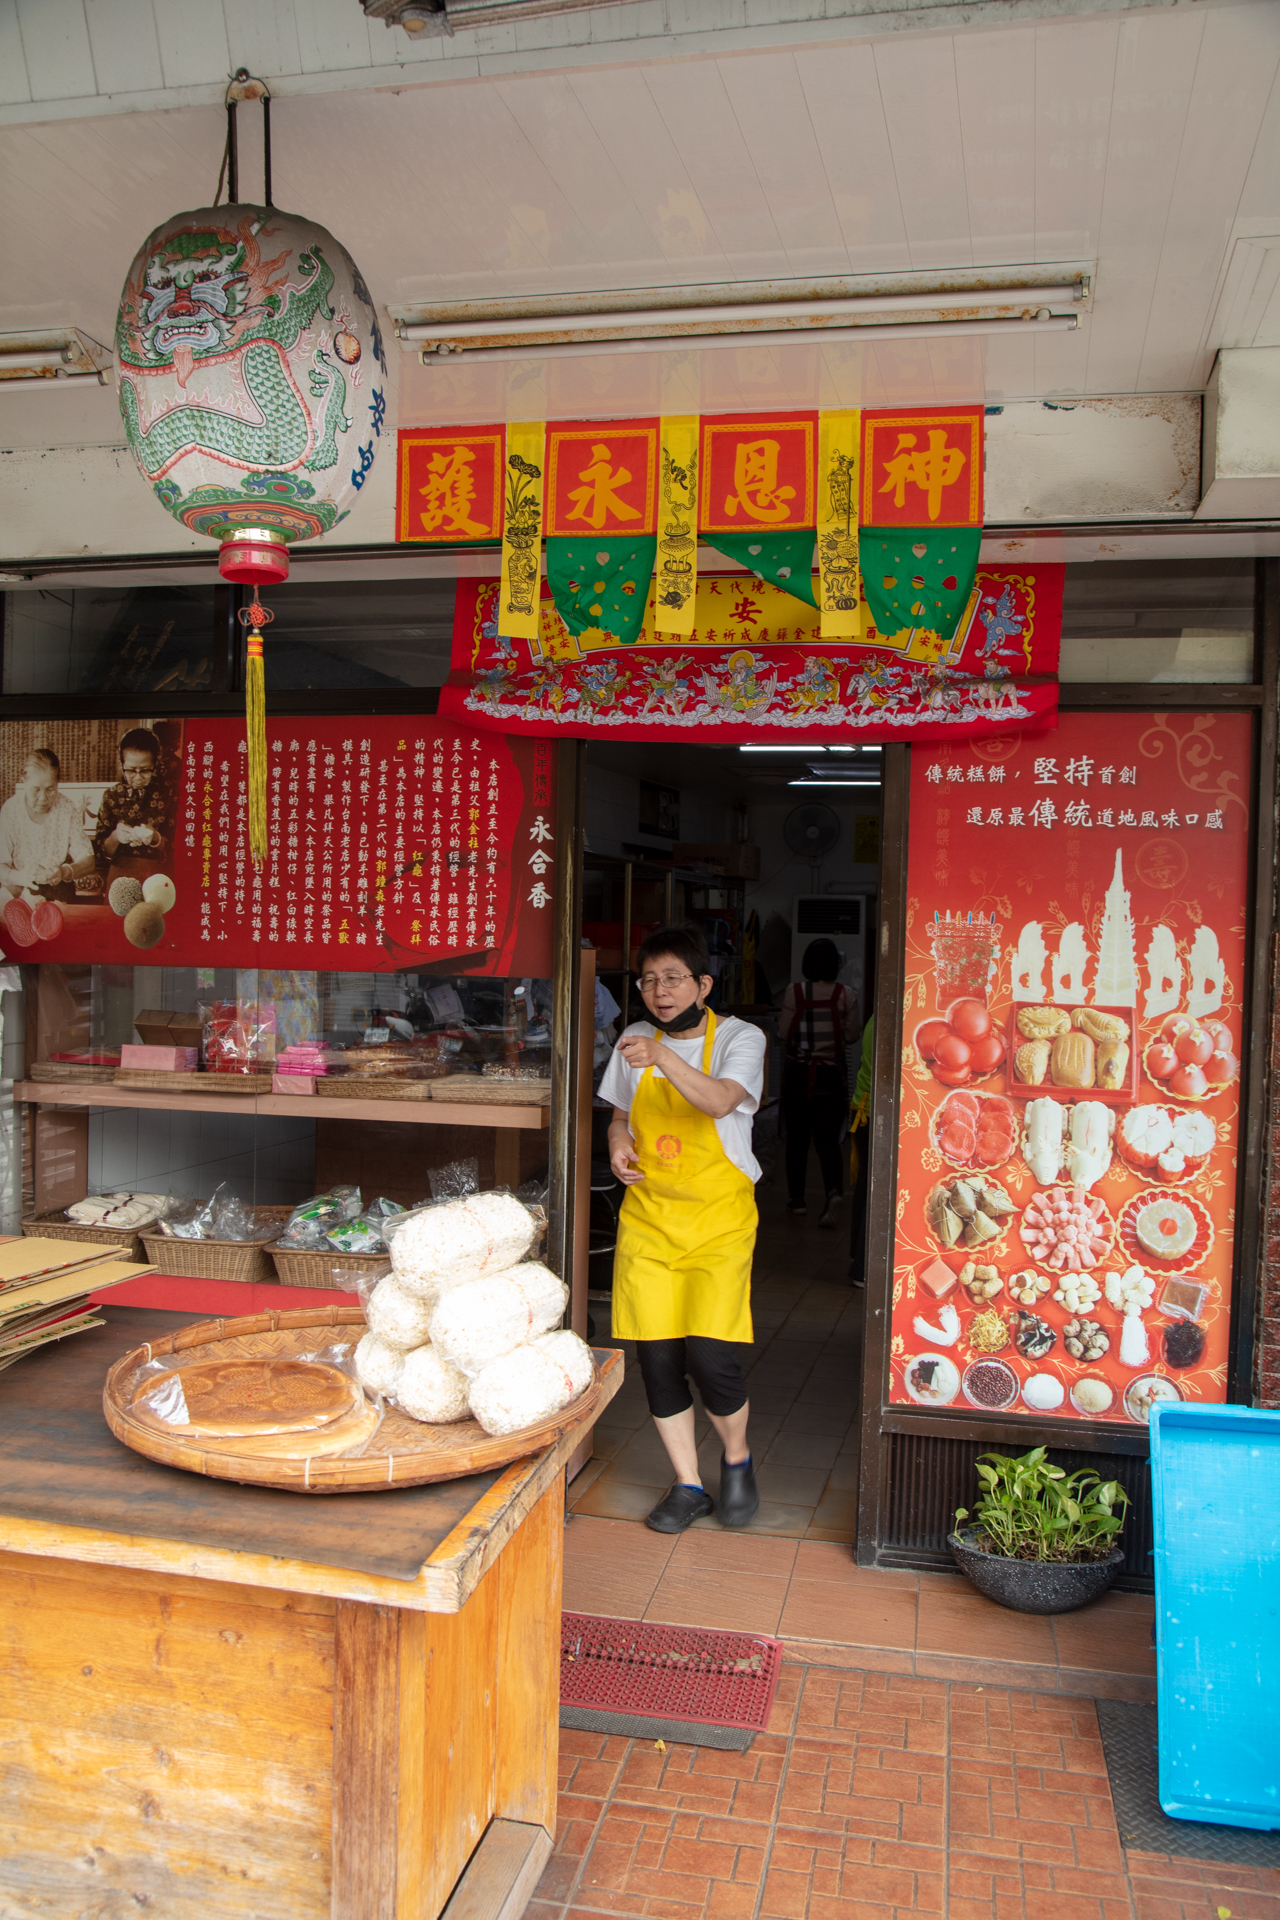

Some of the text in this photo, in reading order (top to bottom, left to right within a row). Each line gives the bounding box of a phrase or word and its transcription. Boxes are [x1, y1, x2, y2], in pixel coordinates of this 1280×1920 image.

[428, 739, 444, 945] 代的變遷，本店仍秉持著傳承民俗
[466, 738, 482, 947] 史，由祖父郭金柱老先生創業傳承
[484, 759, 500, 948] 本店創立至今約有六十年的歷
[526, 815, 554, 909] 永合香
[966, 797, 1223, 830] 還原最傳統道地風味口感
